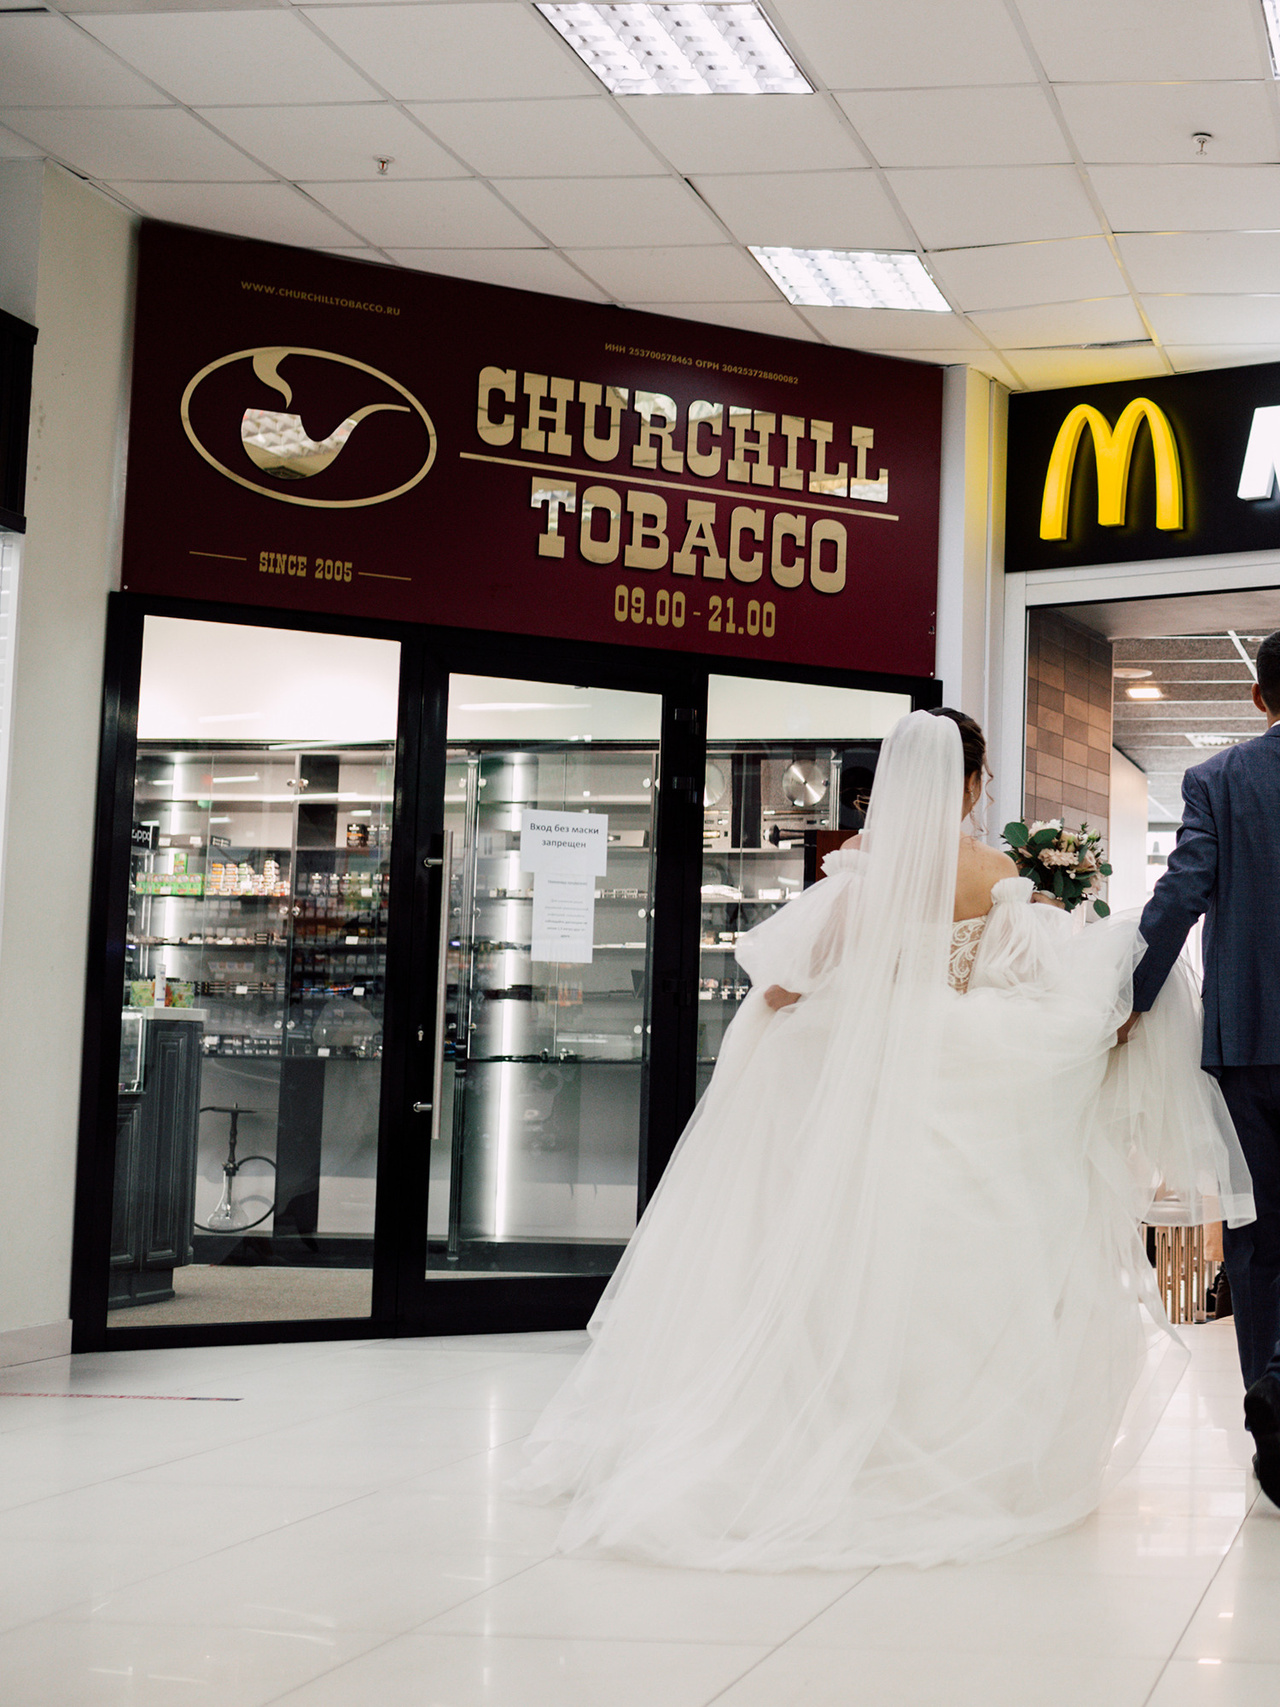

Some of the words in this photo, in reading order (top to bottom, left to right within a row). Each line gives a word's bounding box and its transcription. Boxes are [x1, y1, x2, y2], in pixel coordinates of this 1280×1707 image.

[241, 280, 400, 316] WWW.CHURCHILLTOBACCO.RU
[605, 343, 626, 354] ИНН
[695, 359, 720, 371] ОГРН
[476, 365, 889, 503] CHURCHILL
[531, 476, 848, 594] TOBACCO
[259, 551, 307, 577] SINCE
[315, 558, 353, 582] 2005
[614, 584, 686, 629] 09.00
[708, 595, 777, 638] 21.00
[530, 822, 552, 833] Вход
[554, 823, 570, 833] без
[572, 826, 599, 835] маски
[542, 839, 587, 848] запрещен
